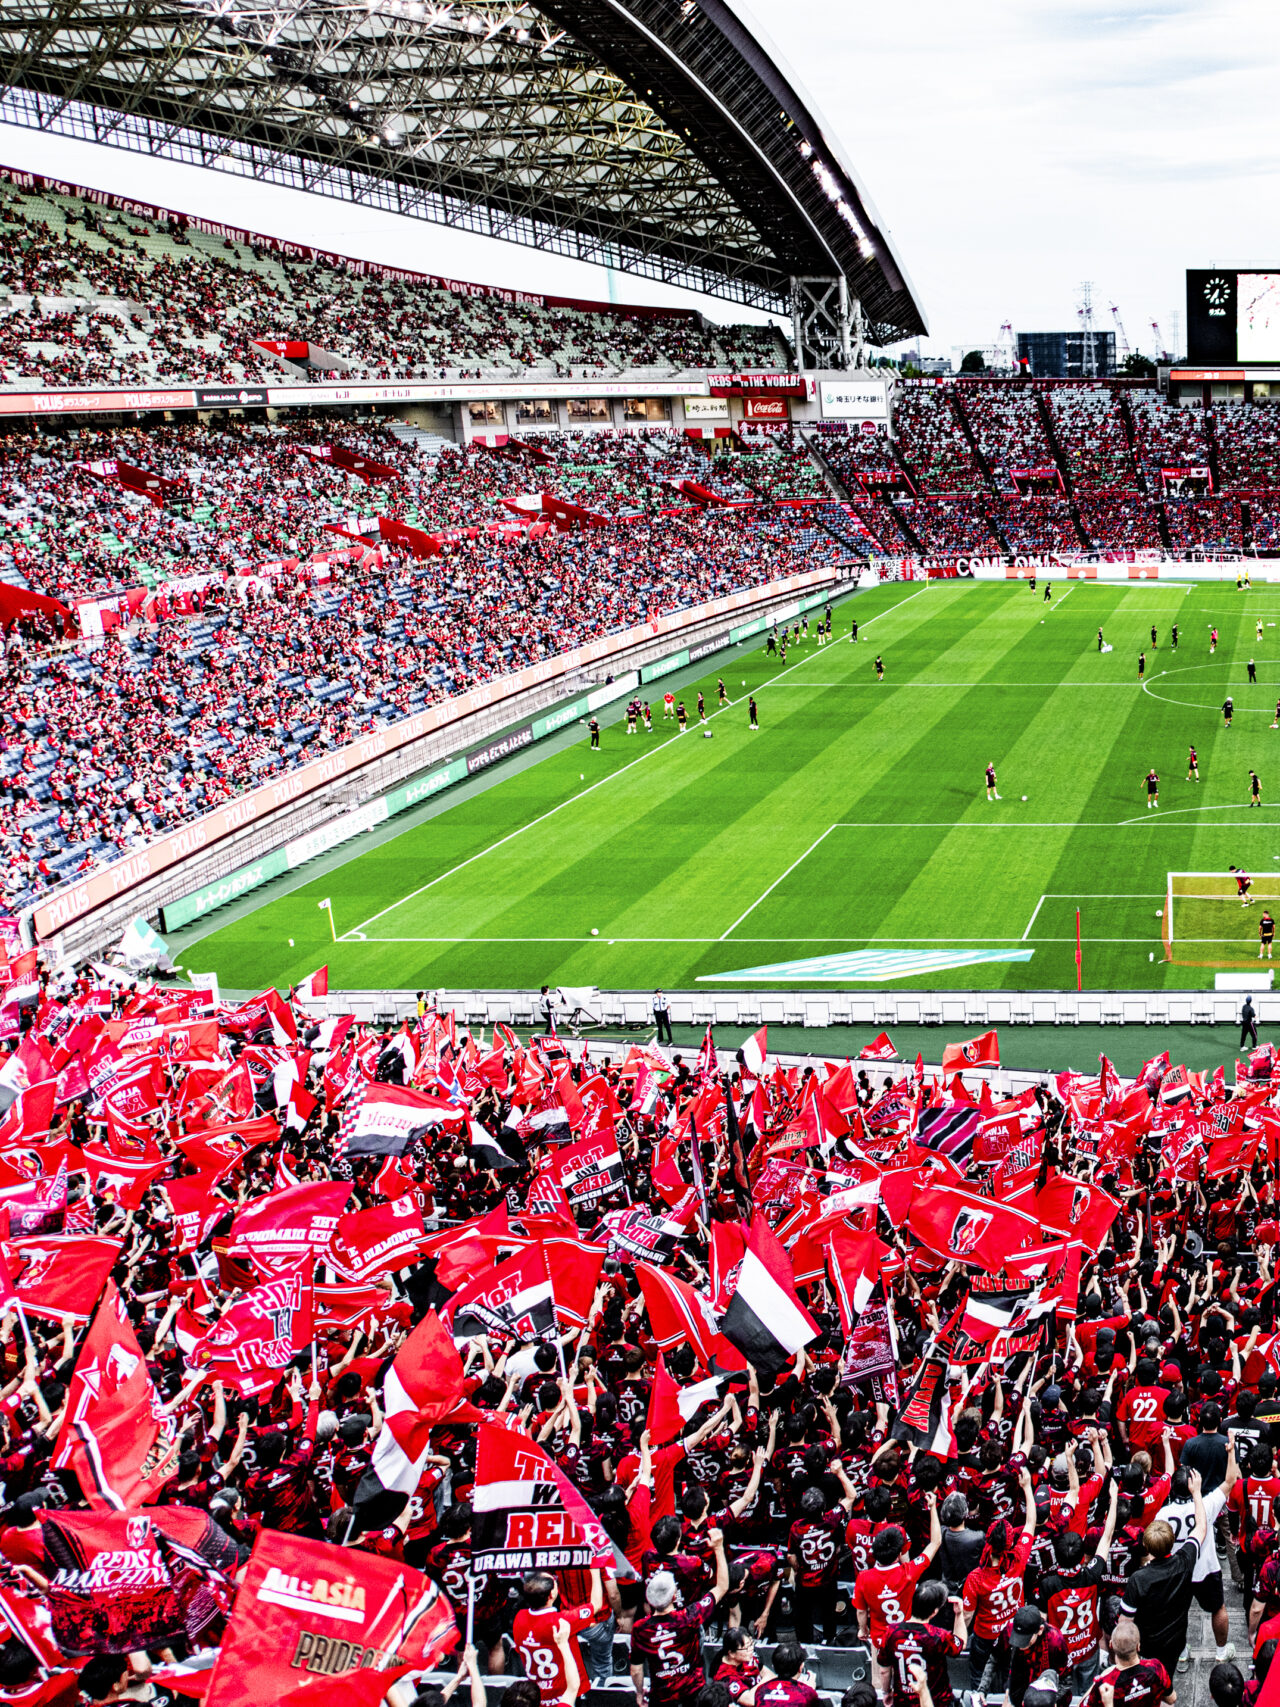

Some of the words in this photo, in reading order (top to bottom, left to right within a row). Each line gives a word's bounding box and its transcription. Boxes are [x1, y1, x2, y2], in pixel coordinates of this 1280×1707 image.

[186, 216, 245, 245] Singing
[708, 375, 731, 387] REDS
[748, 375, 766, 387] THE
[767, 374, 801, 387] WORLD!
[32, 396, 64, 410] POLUS
[124, 394, 152, 409] POLUS
[836, 395, 885, 404] 埼玉りそな銀行
[436, 701, 459, 723] POLUS
[400, 718, 424, 740] POLUS
[361, 735, 386, 758] POLUS
[318, 755, 347, 782] POLUS
[273, 777, 304, 804] POLUS
[223, 798, 257, 830] POLUS
[170, 824, 207, 859] POLUS
[110, 856, 152, 893] POLUS
[47, 886, 91, 929] POLUS
[1133, 1399, 1157, 1422] 22
[90, 1550, 145, 1569] REDS
[475, 1552, 533, 1571] URAWA
[535, 1551, 570, 1570] RED
[800, 1538, 837, 1566] 25
[989, 1580, 1023, 1614] 30
[881, 1600, 905, 1624] 8
[1057, 1600, 1094, 1636] 28
[1067, 1631, 1091, 1645] SCHOLZ
[291, 1630, 366, 1675] PRIDE
[656, 1644, 685, 1671] 5
